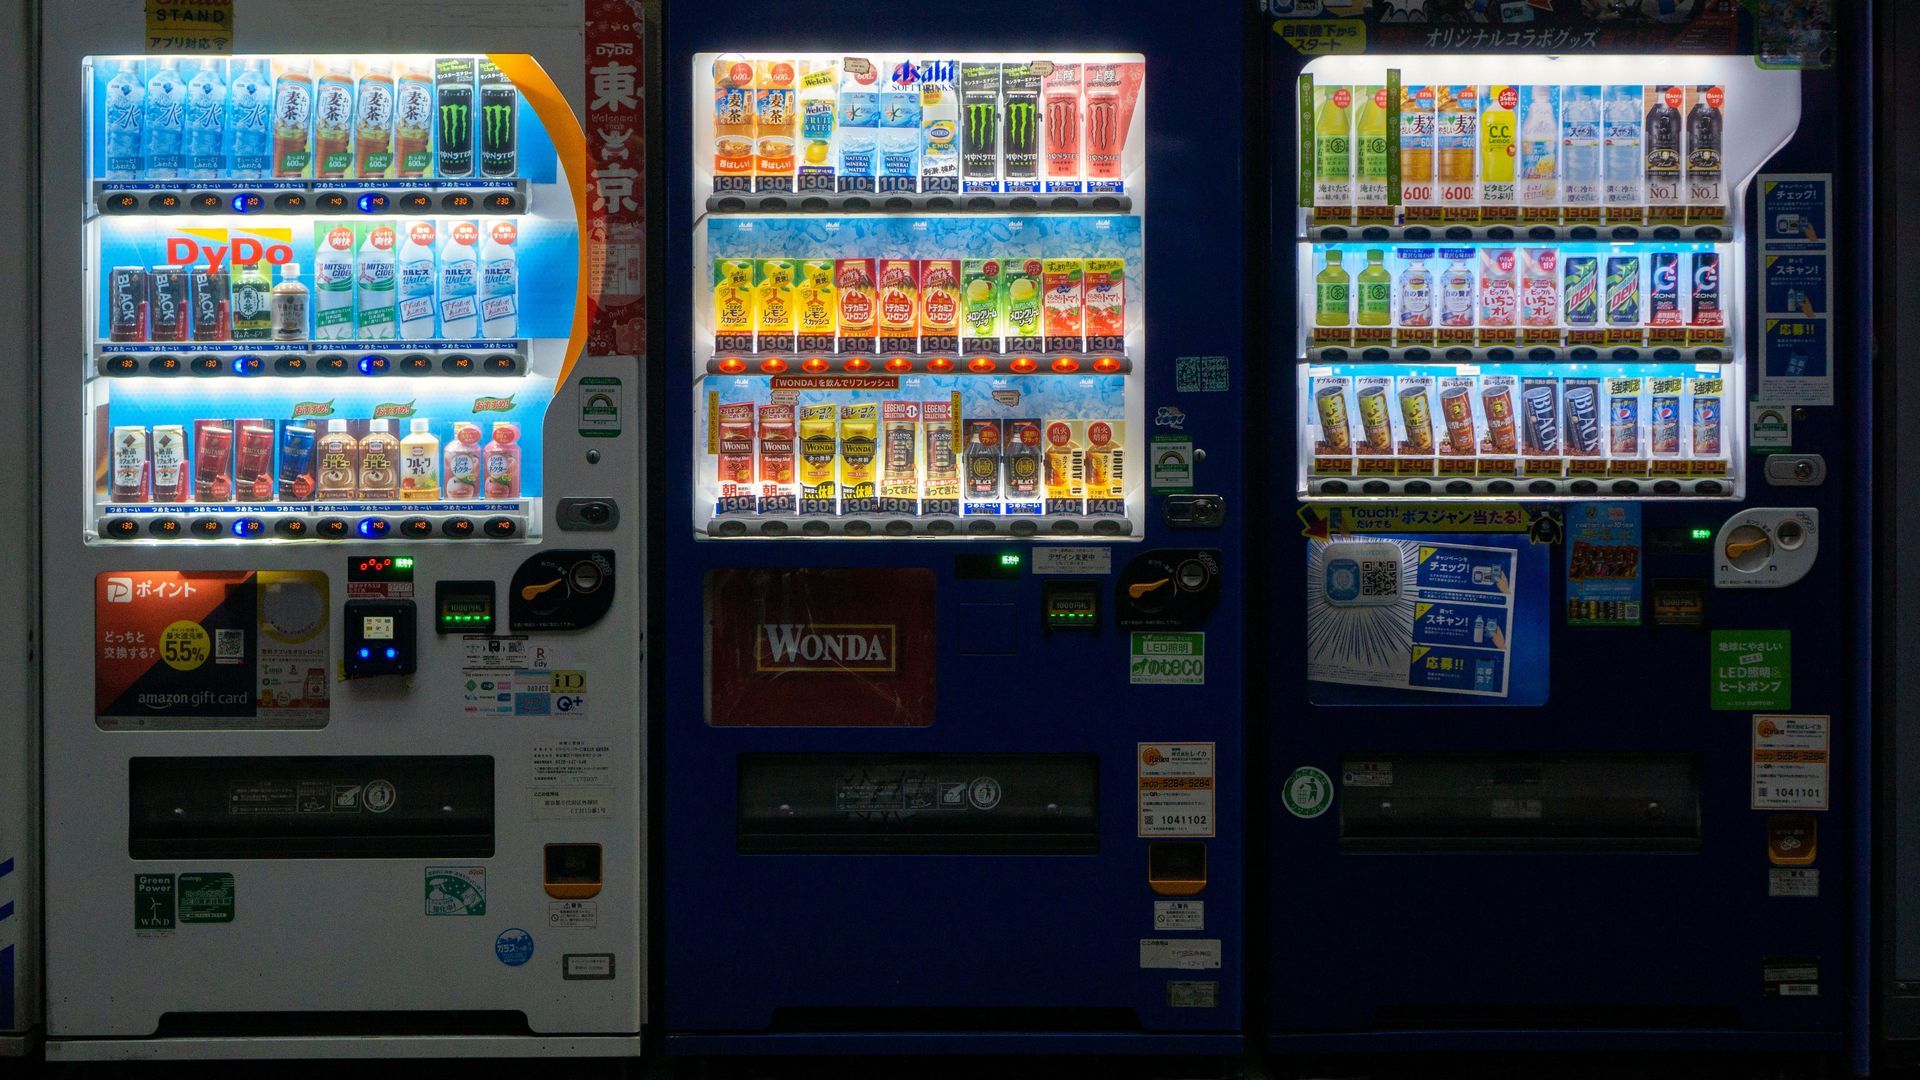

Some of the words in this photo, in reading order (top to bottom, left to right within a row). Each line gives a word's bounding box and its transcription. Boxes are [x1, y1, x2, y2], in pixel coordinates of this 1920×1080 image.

[156, 9, 225, 22] STAND
[1282, 24, 1357, 37] 自販機下から
[150, 37, 210, 49] アプリ対応
[1424, 28, 1599, 49] オリジナルコラボグッズ
[1296, 38, 1343, 51] スタート
[596, 46, 633, 58] DyDo
[892, 58, 955, 83] Asahi
[1054, 69, 1075, 81] 上陸
[1094, 69, 1116, 81] 上陸
[590, 61, 638, 112] 東
[892, 84, 915, 92] SOFT
[919, 84, 955, 92] DRINKS
[728, 94, 742, 123] 麦茶
[769, 94, 784, 123] 麦茶
[805, 104, 831, 114] Welch's
[805, 115, 830, 124] FRUIT
[1489, 126, 1511, 137] C.C.
[927, 142, 954, 150] LEMON
[719, 159, 750, 169] 香ばしい!
[761, 159, 791, 169] 香ばしい!
[591, 163, 639, 213] 京
[1404, 186, 1430, 200] 600
[1445, 186, 1470, 200] 600
[1650, 183, 1677, 200] NO.1
[1691, 183, 1719, 200] NO.1
[1483, 192, 1513, 201] たっぷり!
[1776, 190, 1817, 200] チェック!
[454, 197, 467, 205] 230
[167, 237, 293, 274] DyDo
[1776, 265, 1819, 275] スキャン!
[402, 275, 430, 284] Water
[445, 275, 472, 284] Water
[117, 274, 135, 321] BLACK
[156, 274, 174, 321] BLACK
[1485, 296, 1514, 307] いちご
[1525, 296, 1555, 307] いちご
[843, 303, 869, 311] ドデカミン
[885, 304, 910, 312] ドデカミン
[1491, 307, 1508, 316] オレ
[1532, 307, 1549, 316] オレ
[722, 309, 746, 318] レモン
[763, 309, 787, 318] レモン
[844, 312, 869, 321] ストロング
[886, 312, 910, 321] ストロング
[1779, 323, 1815, 335] 応募!!
[774, 378, 895, 388] 「WONDA」を飲んでリフレッシュ!
[295, 404, 329, 415] おすすめ!
[375, 407, 410, 416] おすすめ!
[884, 404, 905, 412] LEGEND
[924, 404, 946, 413] LEGEND
[1533, 394, 1558, 450] BLACK
[1574, 394, 1600, 450] BLACK
[1052, 426, 1067, 434] 直火
[1093, 426, 1108, 434] 直火
[723, 441, 749, 451] WONDA
[764, 441, 791, 451] WONDA
[322, 460, 350, 469] コーヒー
[363, 460, 391, 469] コーヒー
[406, 458, 431, 468] フルーツ
[722, 484, 737, 497] 朝
[763, 484, 778, 497] 朝
[1350, 506, 1398, 519] Touch!
[1401, 510, 1522, 524] ボスジャン当たる!
[1356, 519, 1392, 529] だけでも
[1429, 563, 1470, 573] チェック!
[136, 580, 196, 598] ポイント
[1426, 614, 1469, 625] スキャン!
[104, 631, 145, 643] どっちと
[764, 624, 886, 663] WONDA
[1146, 643, 1189, 653] LED照明
[1718, 642, 1783, 651] 地球にやさしい
[104, 647, 155, 659] 交換する?
[165, 641, 204, 662] 5.5%
[534, 660, 547, 668] Edy
[1425, 657, 1464, 671] 応募!!
[1719, 681, 1782, 692] ヒートポンプ
[138, 692, 188, 705] amazon
[193, 692, 218, 707] gift
[218, 692, 247, 704] card
[1775, 788, 1820, 797] 1041101
[1161, 815, 1207, 825] 1041102
[139, 877, 170, 885] Green
[138, 884, 172, 892] Power
[141, 918, 170, 926] WIND
